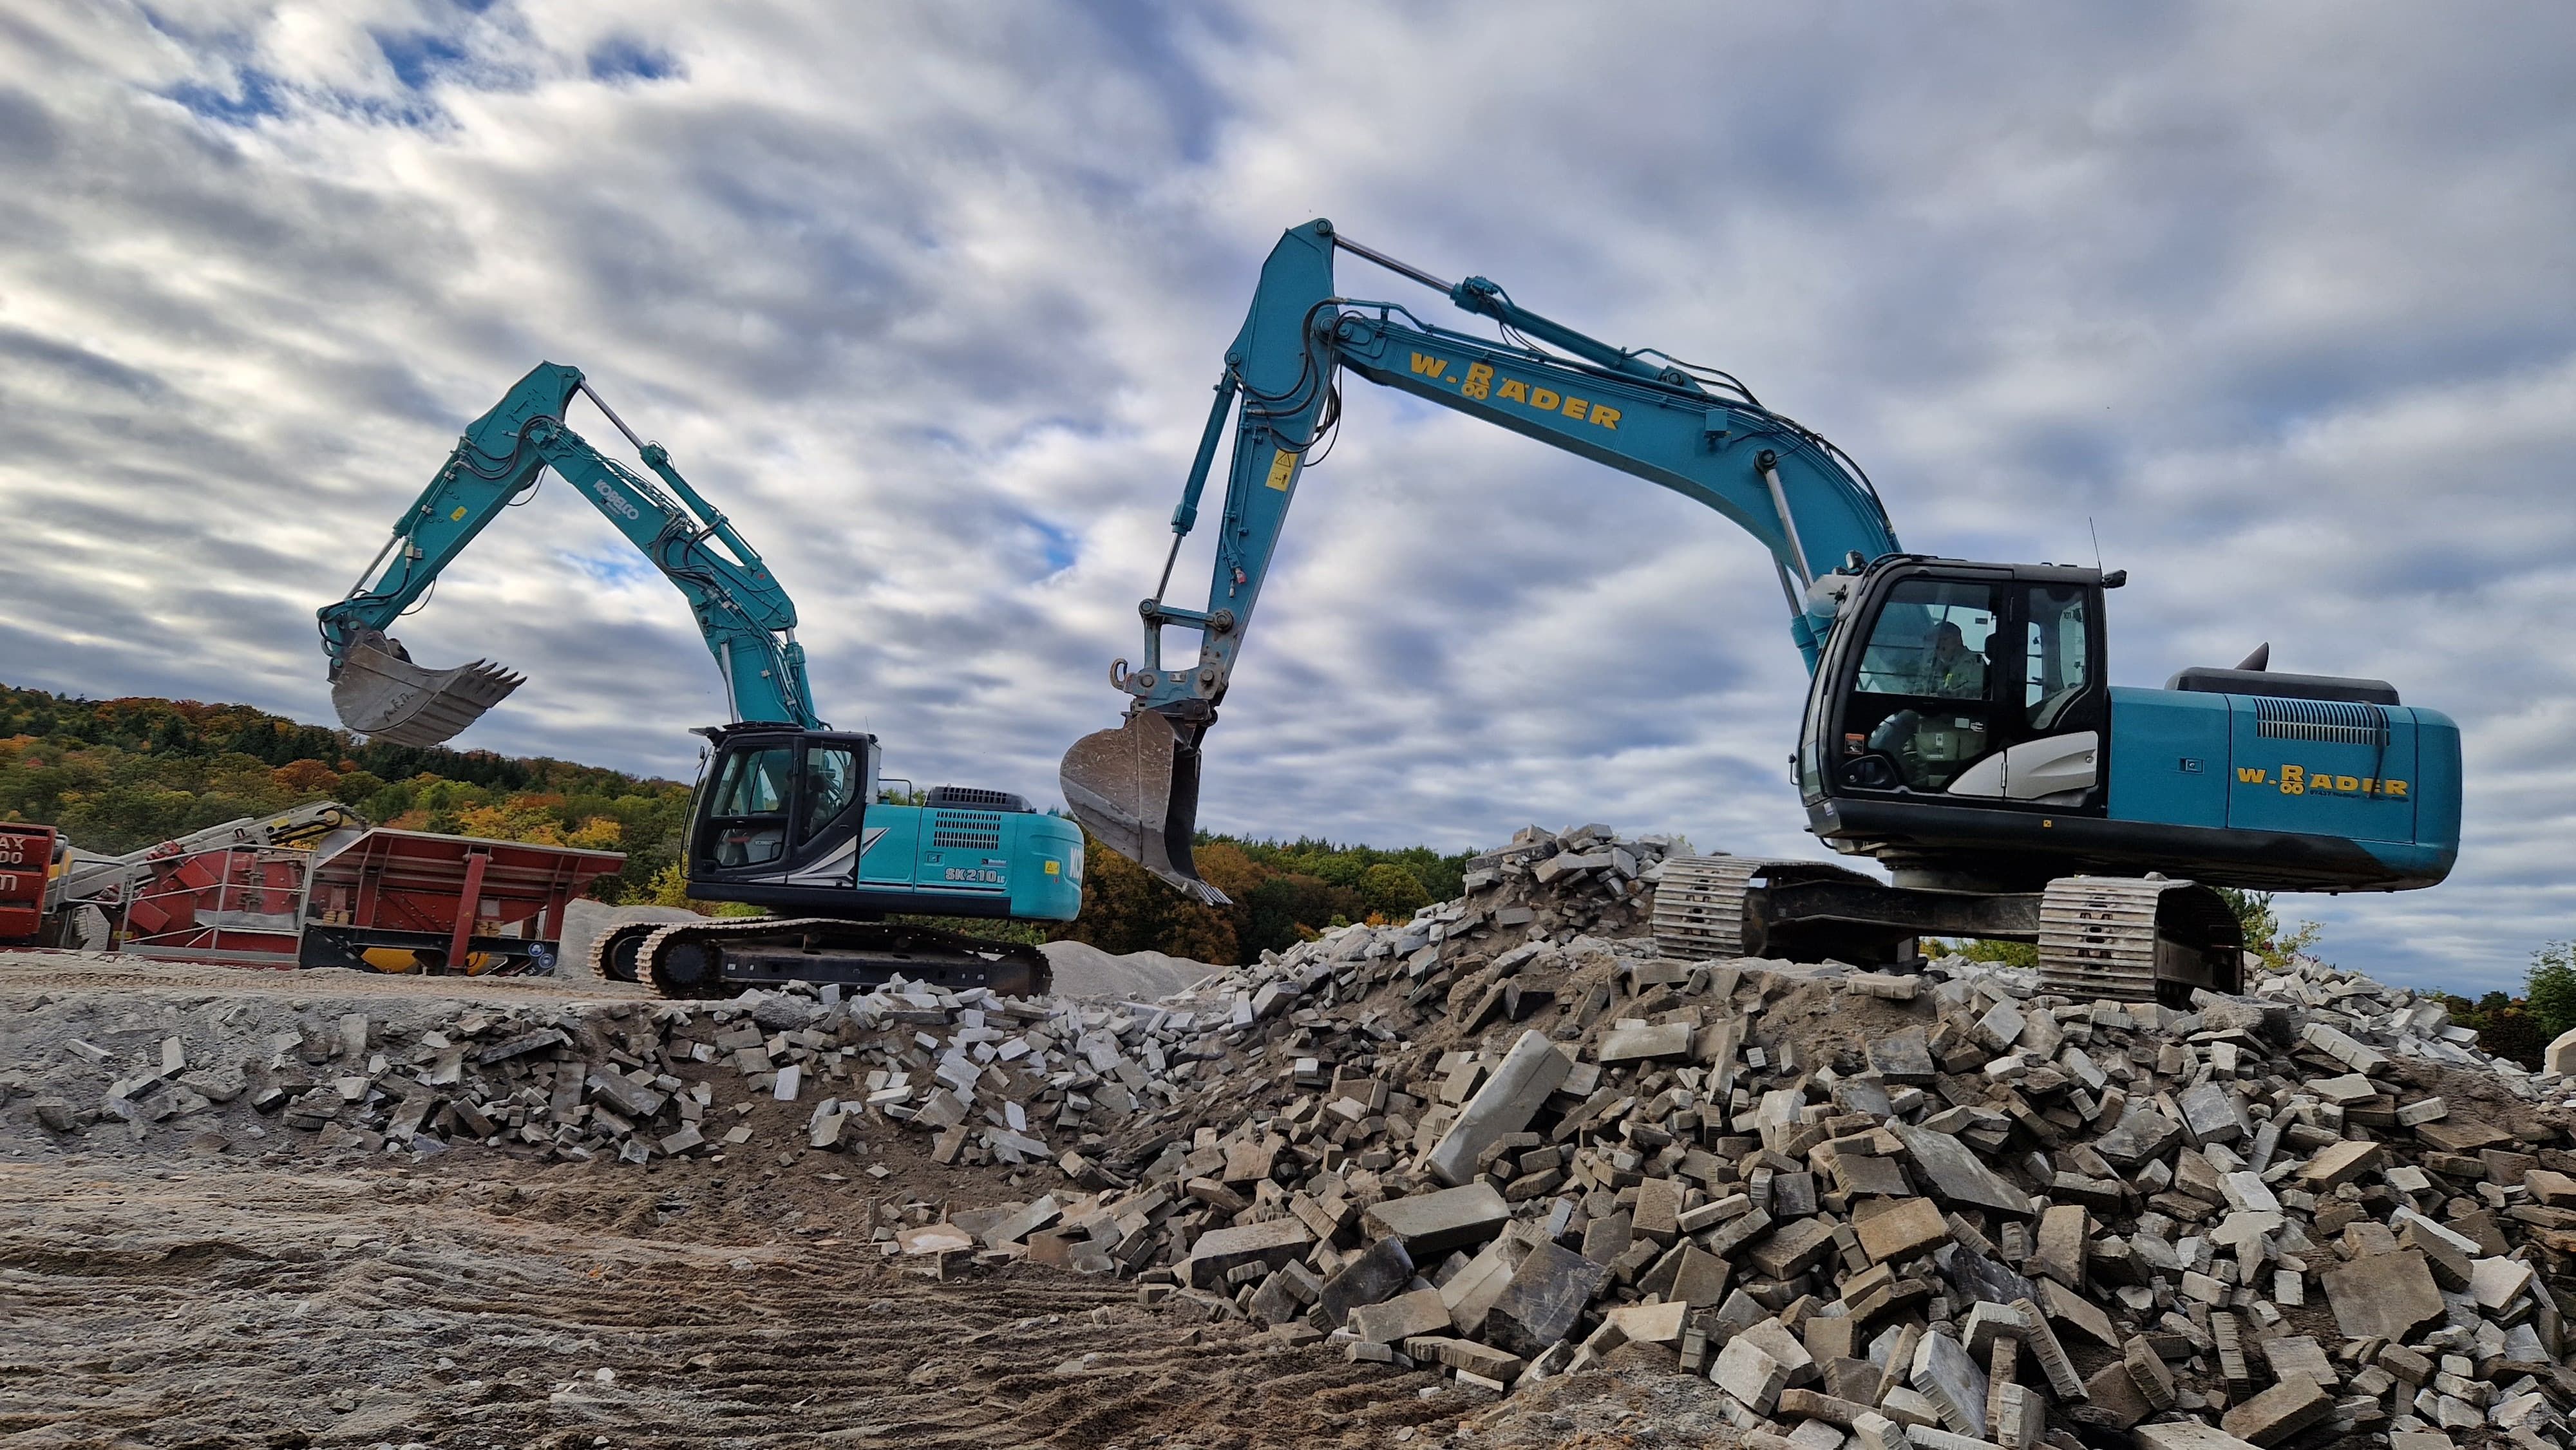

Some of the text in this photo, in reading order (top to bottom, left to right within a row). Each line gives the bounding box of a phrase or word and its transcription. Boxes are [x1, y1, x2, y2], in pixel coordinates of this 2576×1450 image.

[1461, 362, 1622, 429] RÄDER
[593, 478, 639, 520] KOBELCO
[2280, 764, 2408, 795] RÄDER
[1070, 847, 1084, 880] KO
